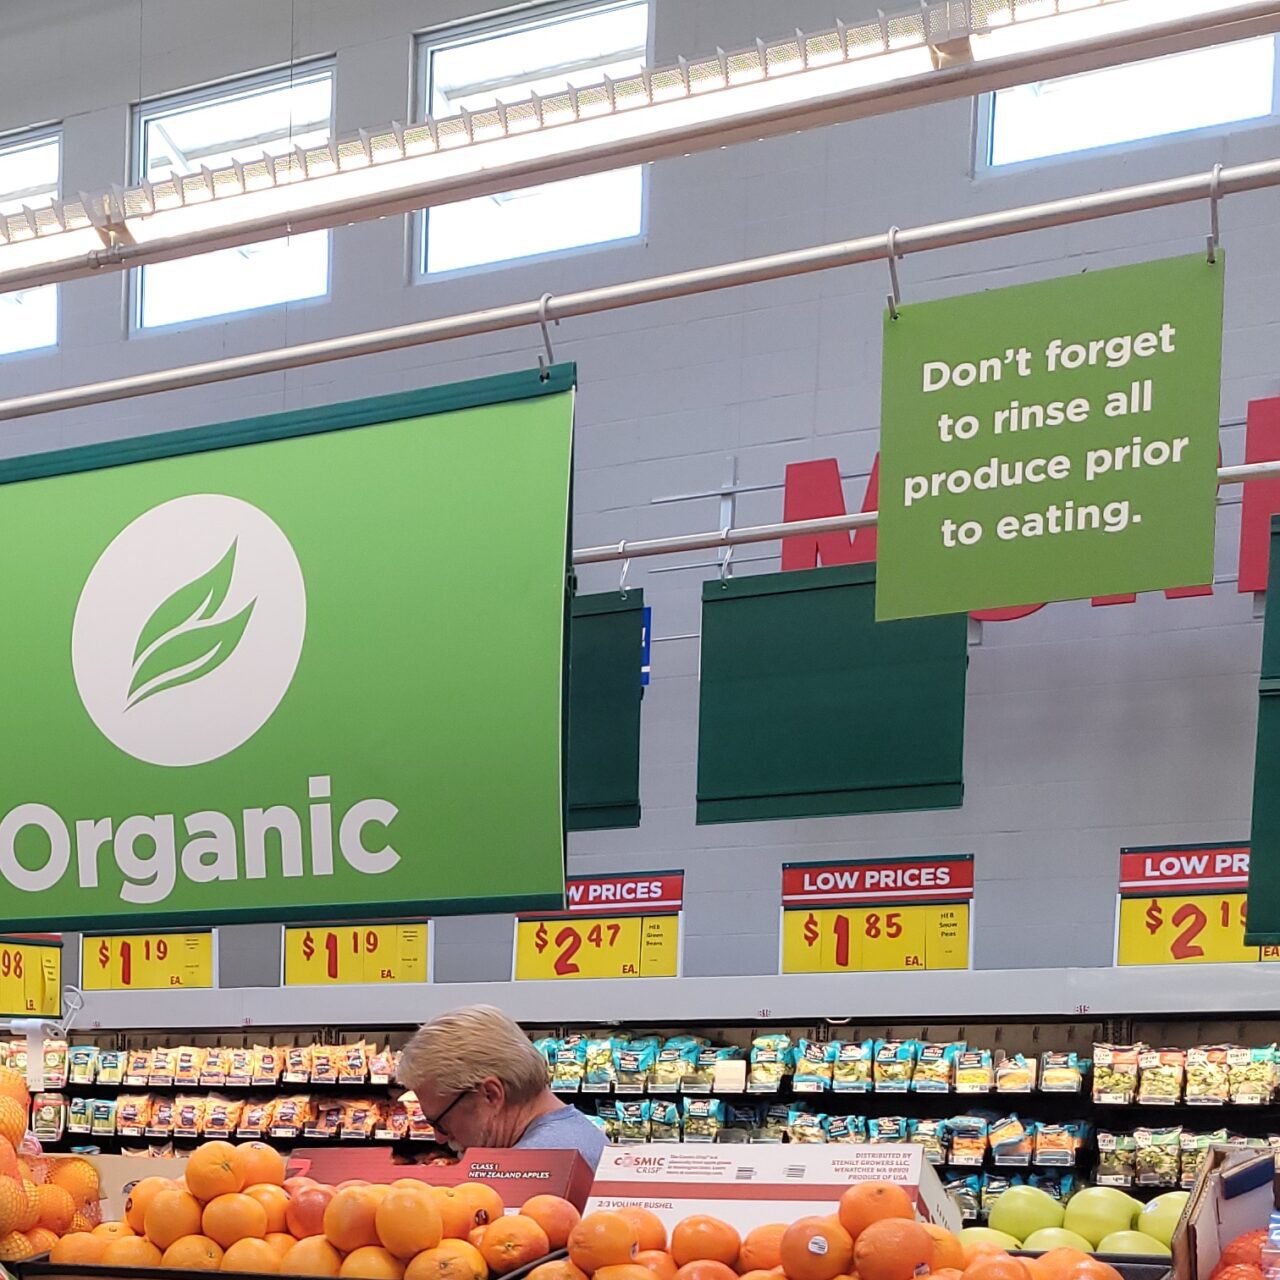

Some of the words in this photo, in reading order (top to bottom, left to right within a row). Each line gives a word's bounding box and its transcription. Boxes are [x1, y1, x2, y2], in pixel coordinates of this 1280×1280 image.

[1046, 323, 1176, 373] forget
[938, 412, 980, 443] to
[993, 395, 1090, 436] rinse
[1104, 380, 1153, 418] all
[903, 454, 1071, 507] produce
[1085, 434, 1190, 482] prior
[941, 518, 983, 549] to
[996, 499, 1142, 542] eating.
[588, 881, 663, 901] PRICES
[803, 871, 860, 891] LOW
[865, 867, 951, 888] PRICES
[1145, 855, 1209, 877] LOW
